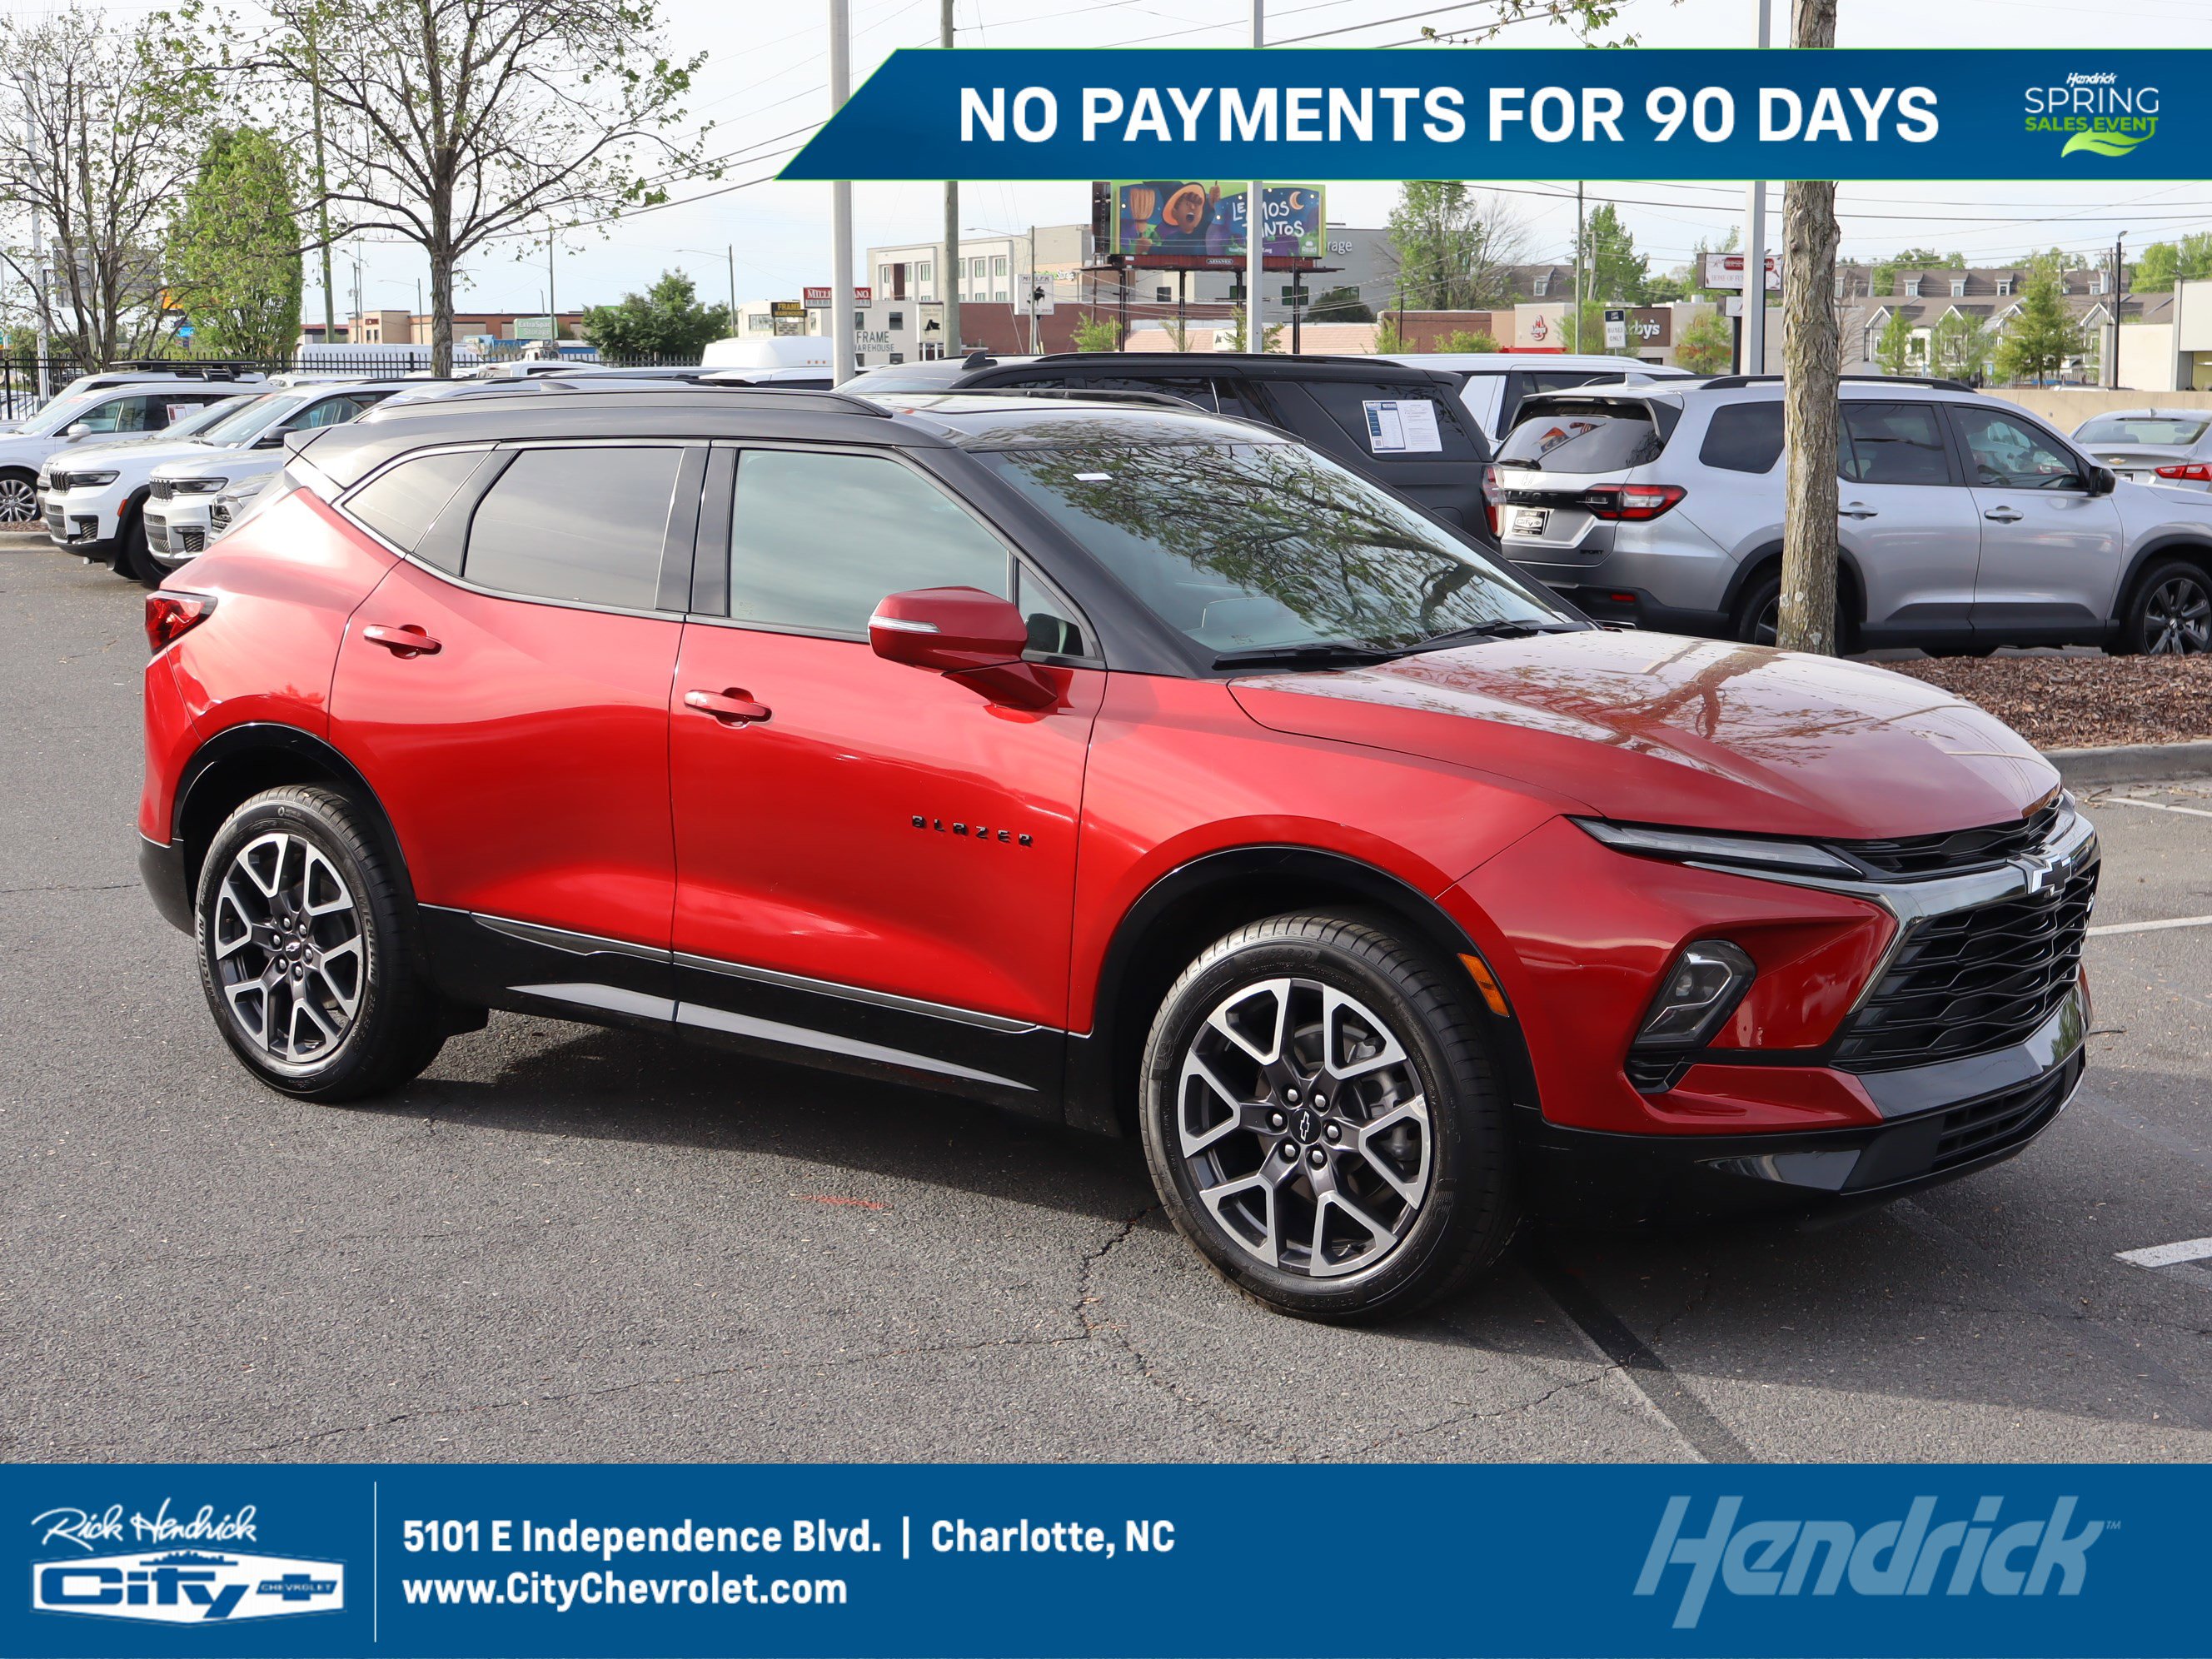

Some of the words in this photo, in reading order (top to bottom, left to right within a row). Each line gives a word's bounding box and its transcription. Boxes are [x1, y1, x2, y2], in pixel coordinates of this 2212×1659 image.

[1233, 201, 1290, 222] LEOS
[1327, 241, 1353, 254] rage
[518, 320, 551, 328] ExtraSpac
[856, 331, 889, 343] FRAME
[912, 815, 1034, 848] BLAZER
[359, 893, 377, 980] MICHELIN
[198, 918, 215, 999] MICHELIN
